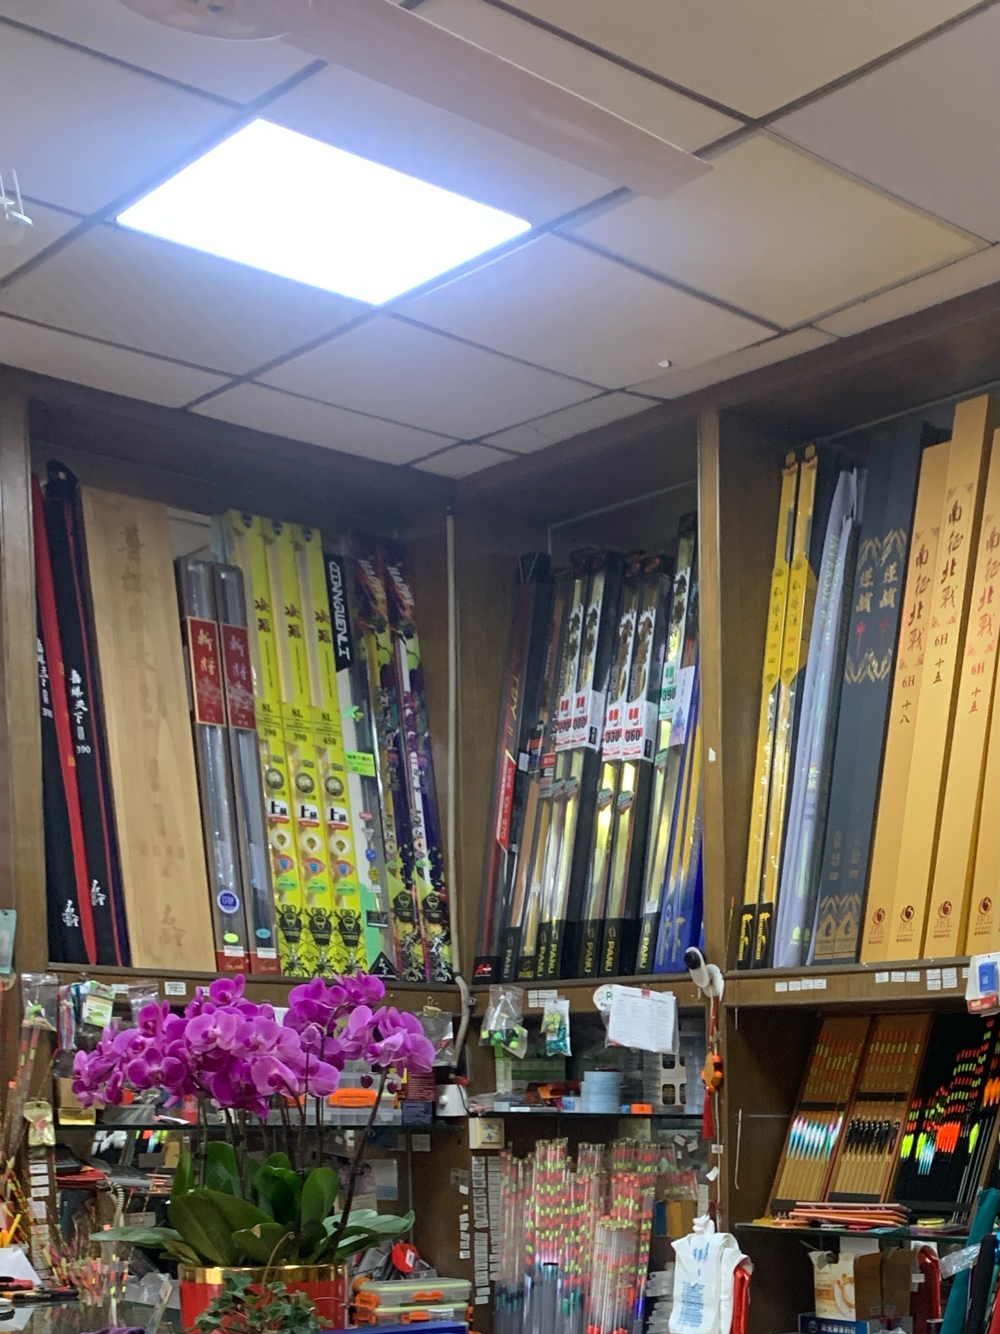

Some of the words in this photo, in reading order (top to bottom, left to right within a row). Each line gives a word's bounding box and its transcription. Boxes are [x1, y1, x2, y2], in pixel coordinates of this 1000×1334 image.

[934, 632, 948, 646] 6H
[902, 676, 916, 688] 6H
[970, 662, 985, 675] 6H
[76, 746, 91, 754] 390
[537, 946, 546, 977] PANU
[548, 944, 556, 974] PANU
[584, 942, 594, 972] PANU
[606, 940, 614, 972] PANU
[640, 938, 649, 968] PANU
